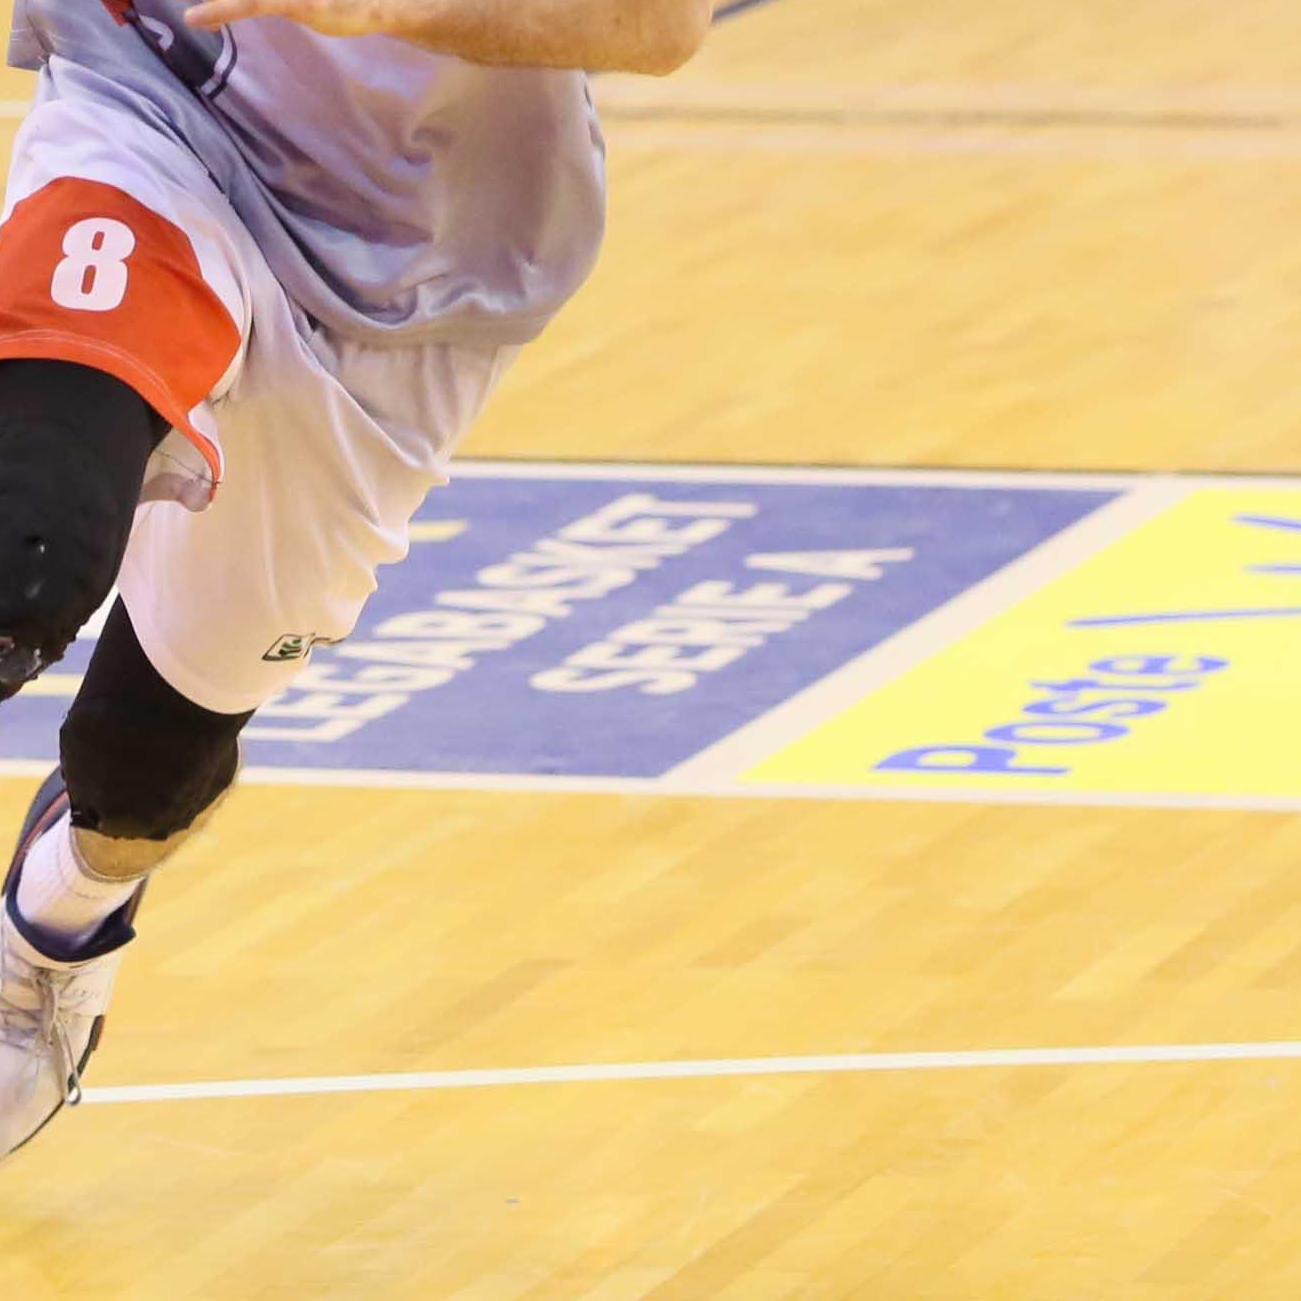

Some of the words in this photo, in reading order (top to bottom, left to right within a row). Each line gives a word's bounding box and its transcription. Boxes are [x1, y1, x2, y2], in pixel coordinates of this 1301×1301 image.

[50, 216, 137, 313] 8
[242, 493, 759, 745] LEGABASKET
[529, 577, 854, 697] SERIE
[745, 545, 916, 584] A
[869, 654, 1230, 776] Poste
